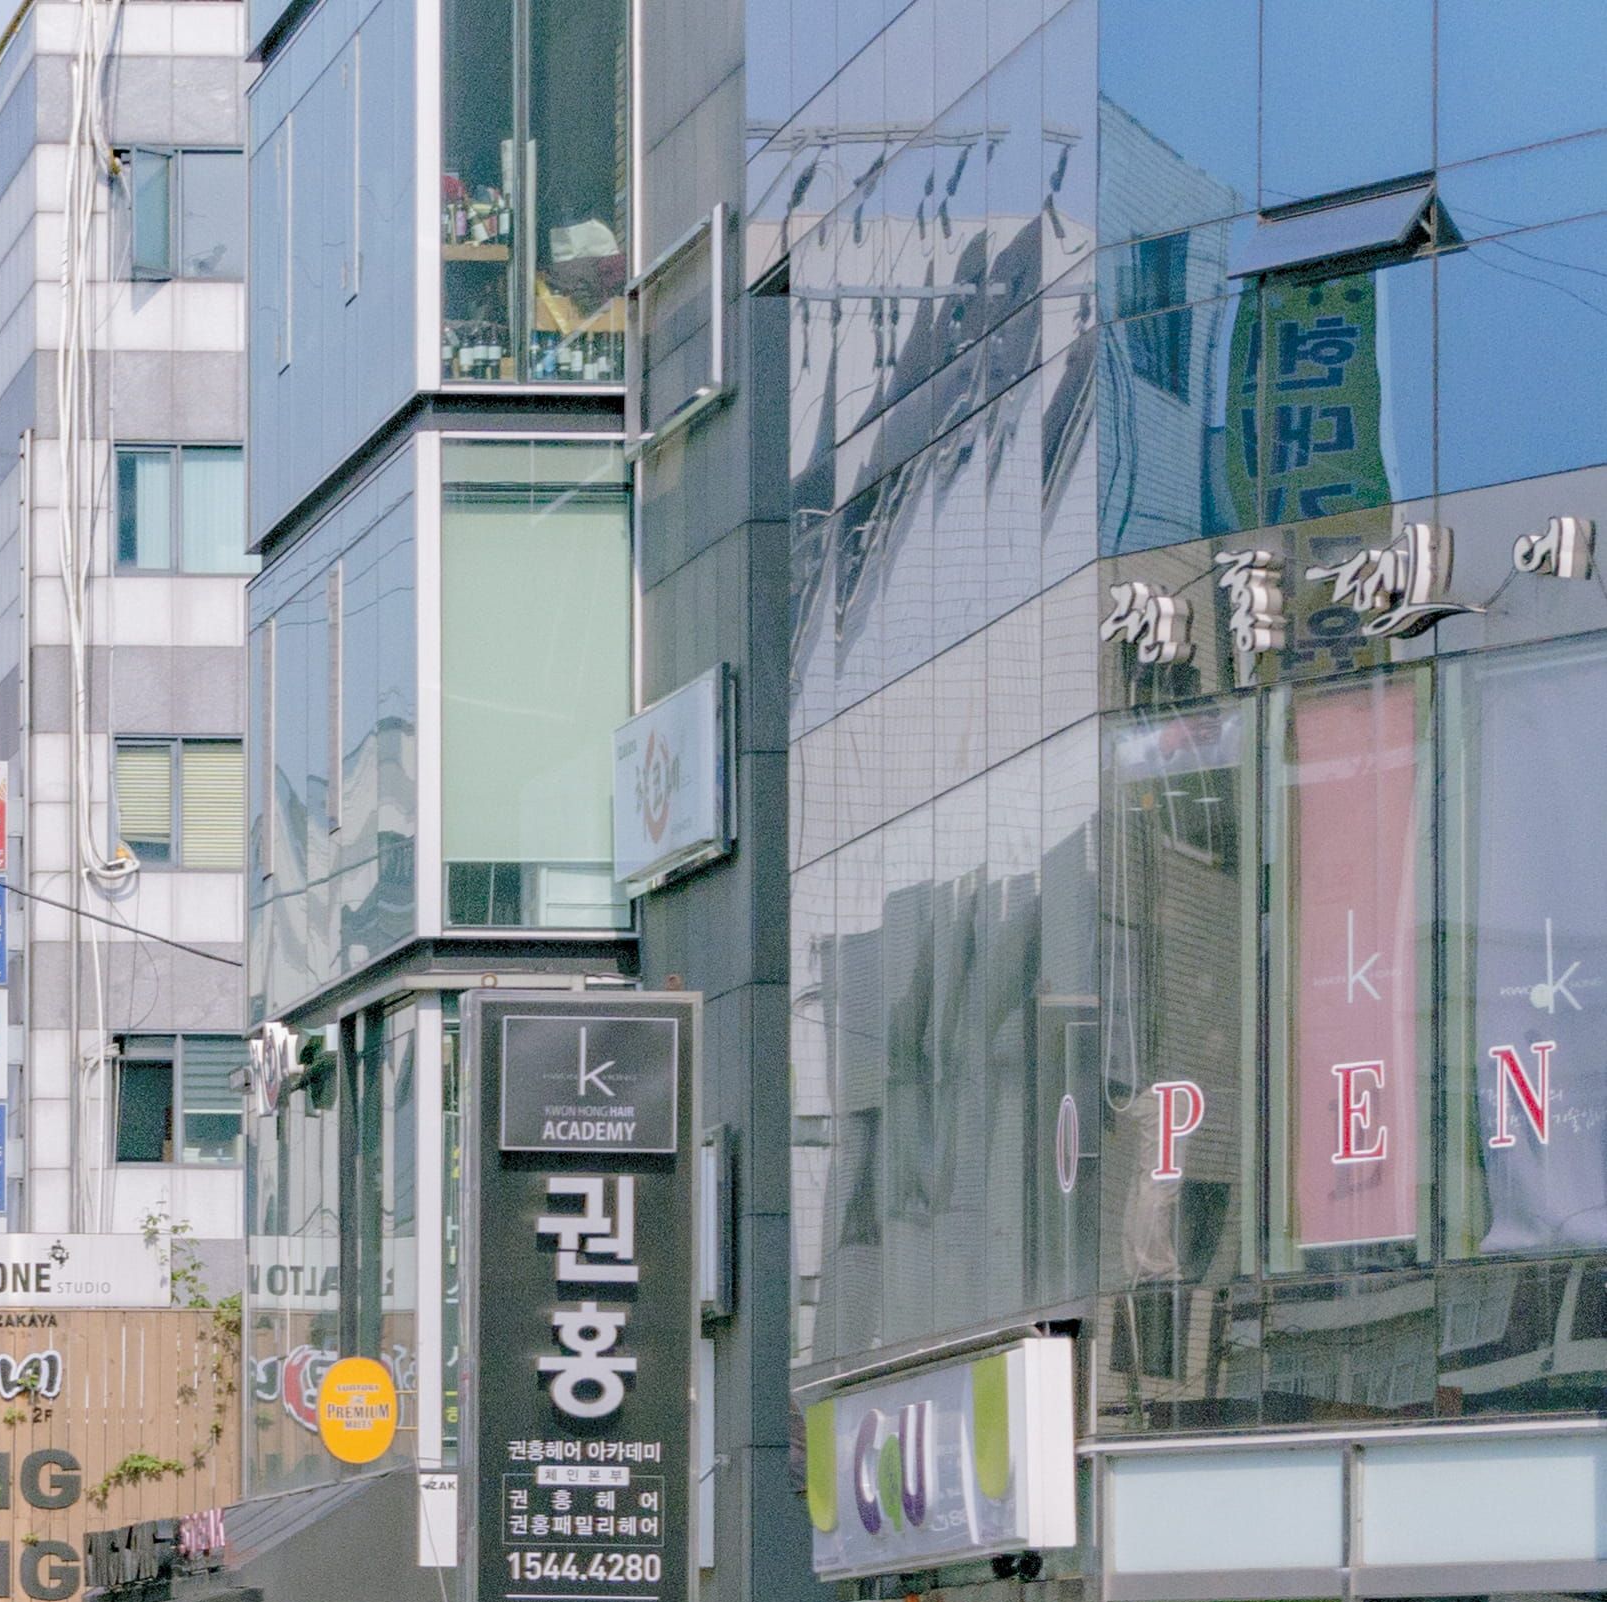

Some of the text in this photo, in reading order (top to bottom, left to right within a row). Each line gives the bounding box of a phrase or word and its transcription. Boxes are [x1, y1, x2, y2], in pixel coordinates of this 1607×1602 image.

[545, 1105, 635, 1118] KWON HONG HAIR
[543, 1121, 637, 1141] ACADEMY
[56, 1280, 112, 1294] STUDIO
[31, 1407, 54, 1423] 2F
[327, 1403, 389, 1419] PREMIUM
[509, 1440, 661, 1462] 권홍헤어 아카데미
[509, 1489, 658, 1512] 권홍헤어
[509, 1514, 658, 1537] 권홍패밀리헤어
[506, 1551, 662, 1583] 1544.4280
